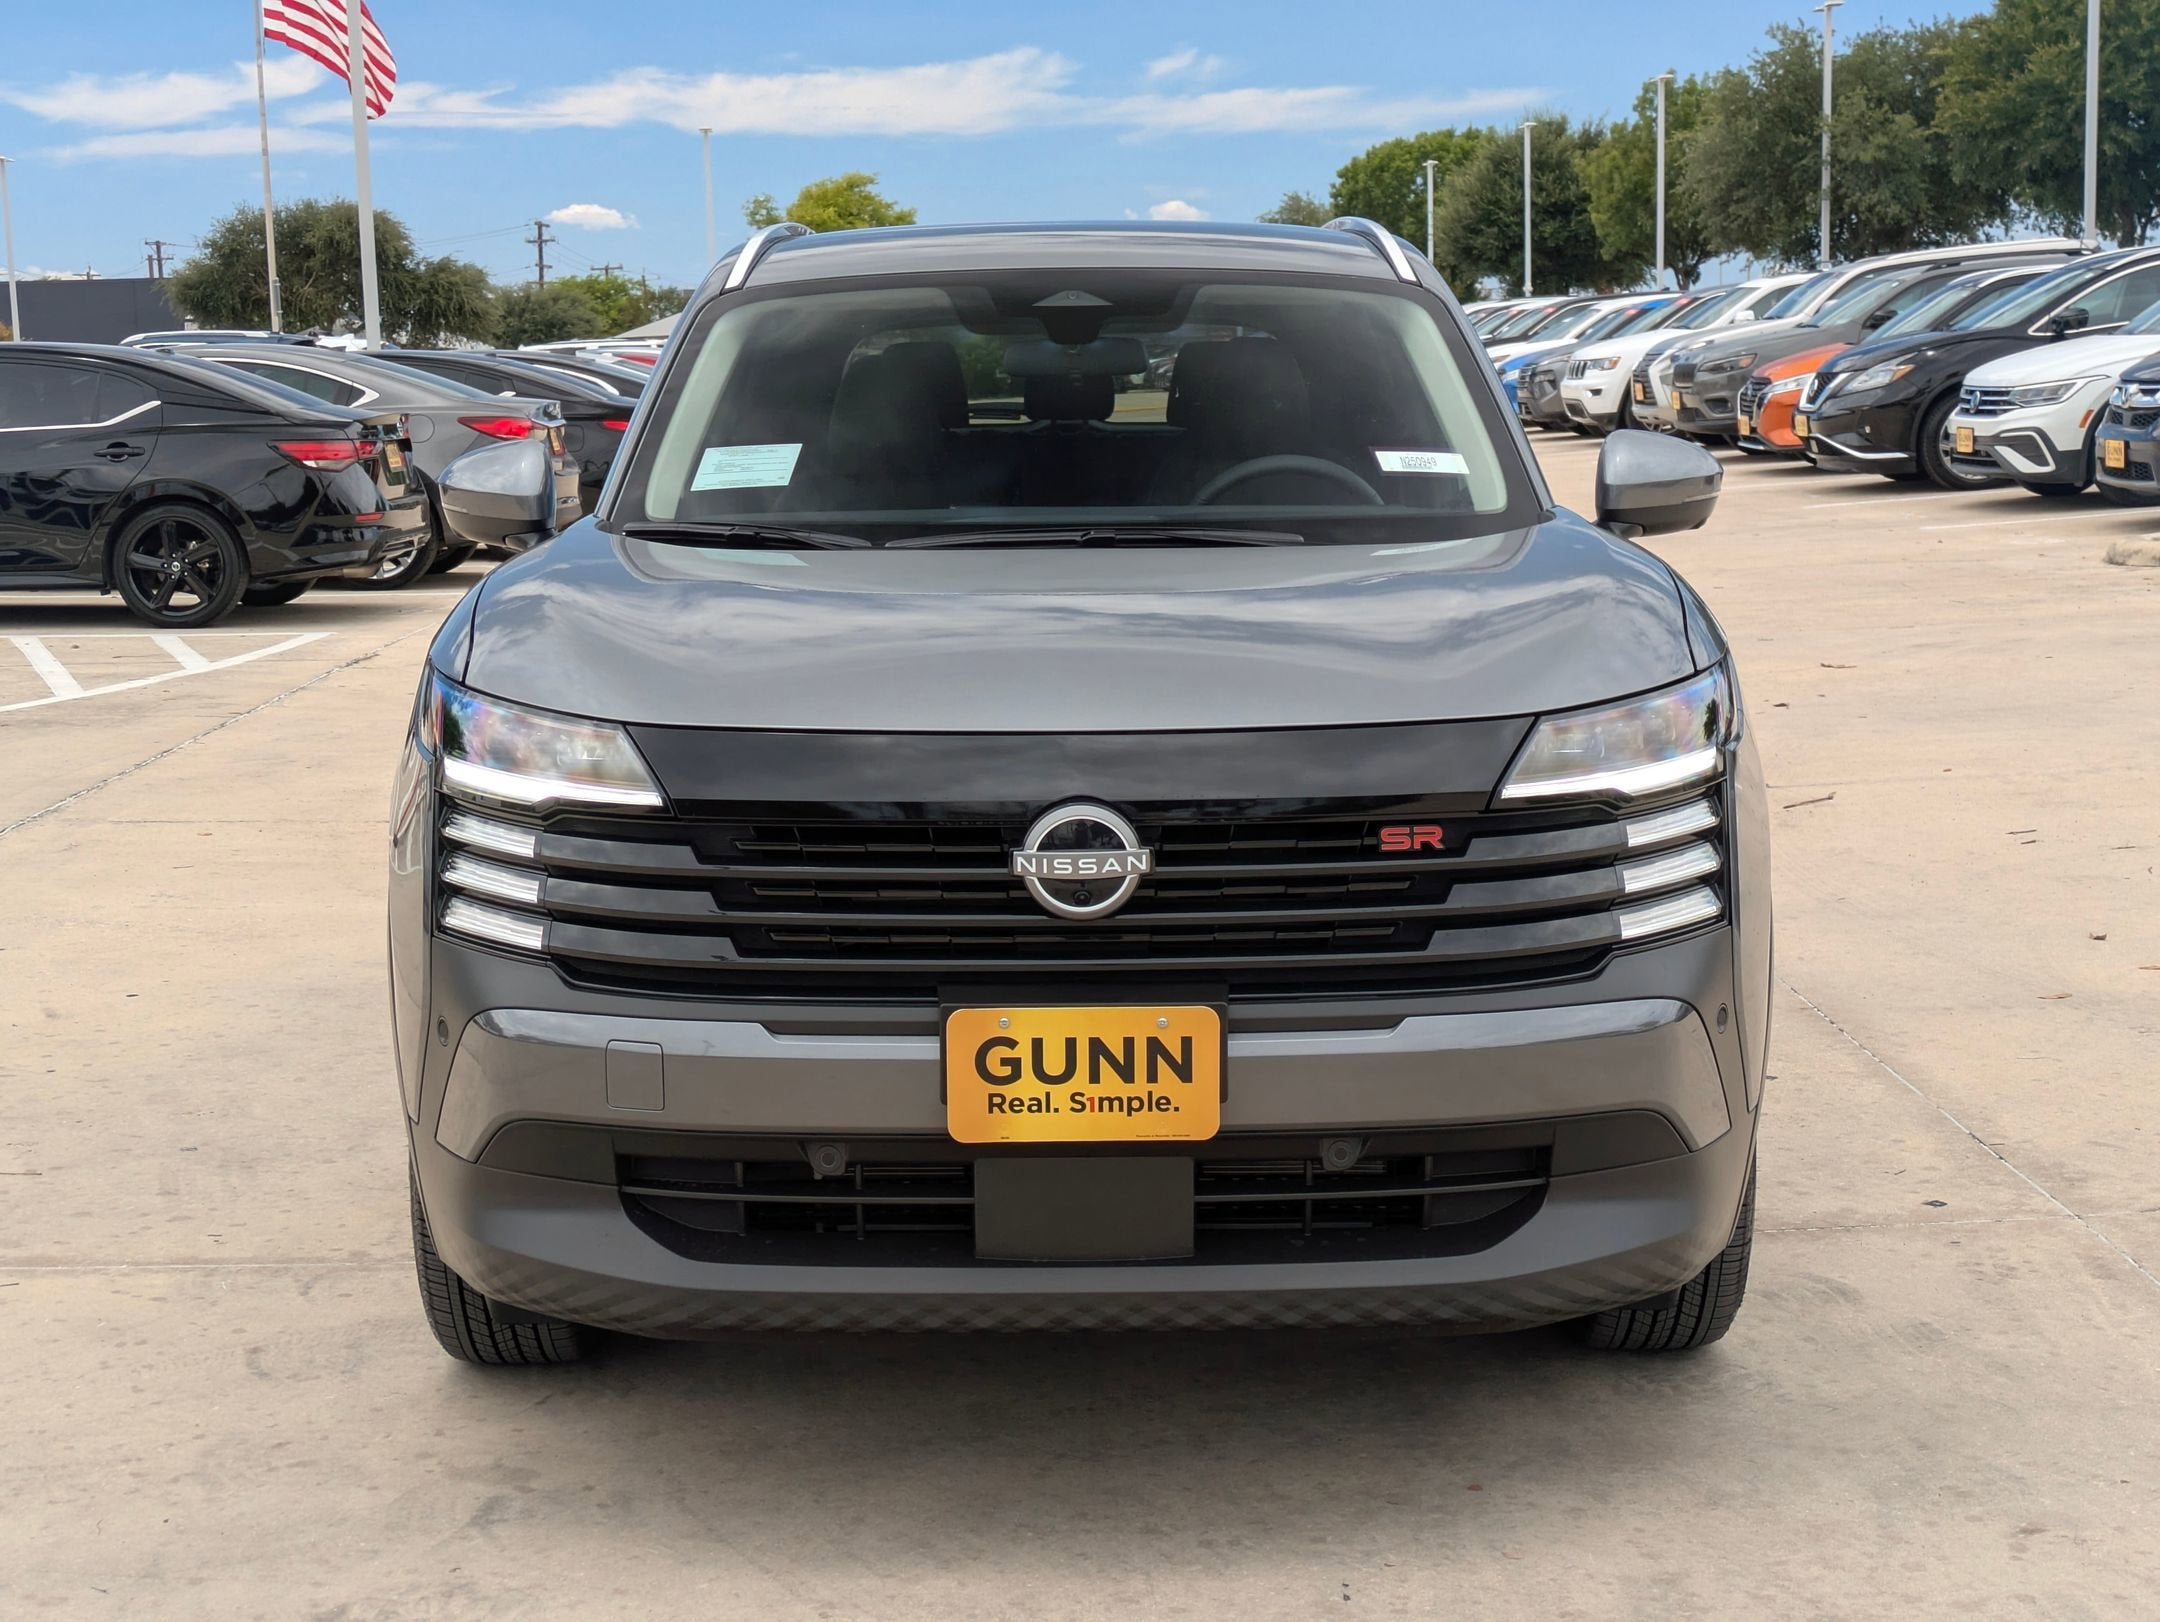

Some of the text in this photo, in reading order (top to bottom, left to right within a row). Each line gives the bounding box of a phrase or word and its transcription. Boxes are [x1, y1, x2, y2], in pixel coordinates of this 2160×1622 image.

[1380, 826, 1445, 850] SR
[1016, 854, 1147, 874] NISSAN
[974, 1036, 1193, 1086] GUNN
[987, 1091, 1060, 1114] Real.
